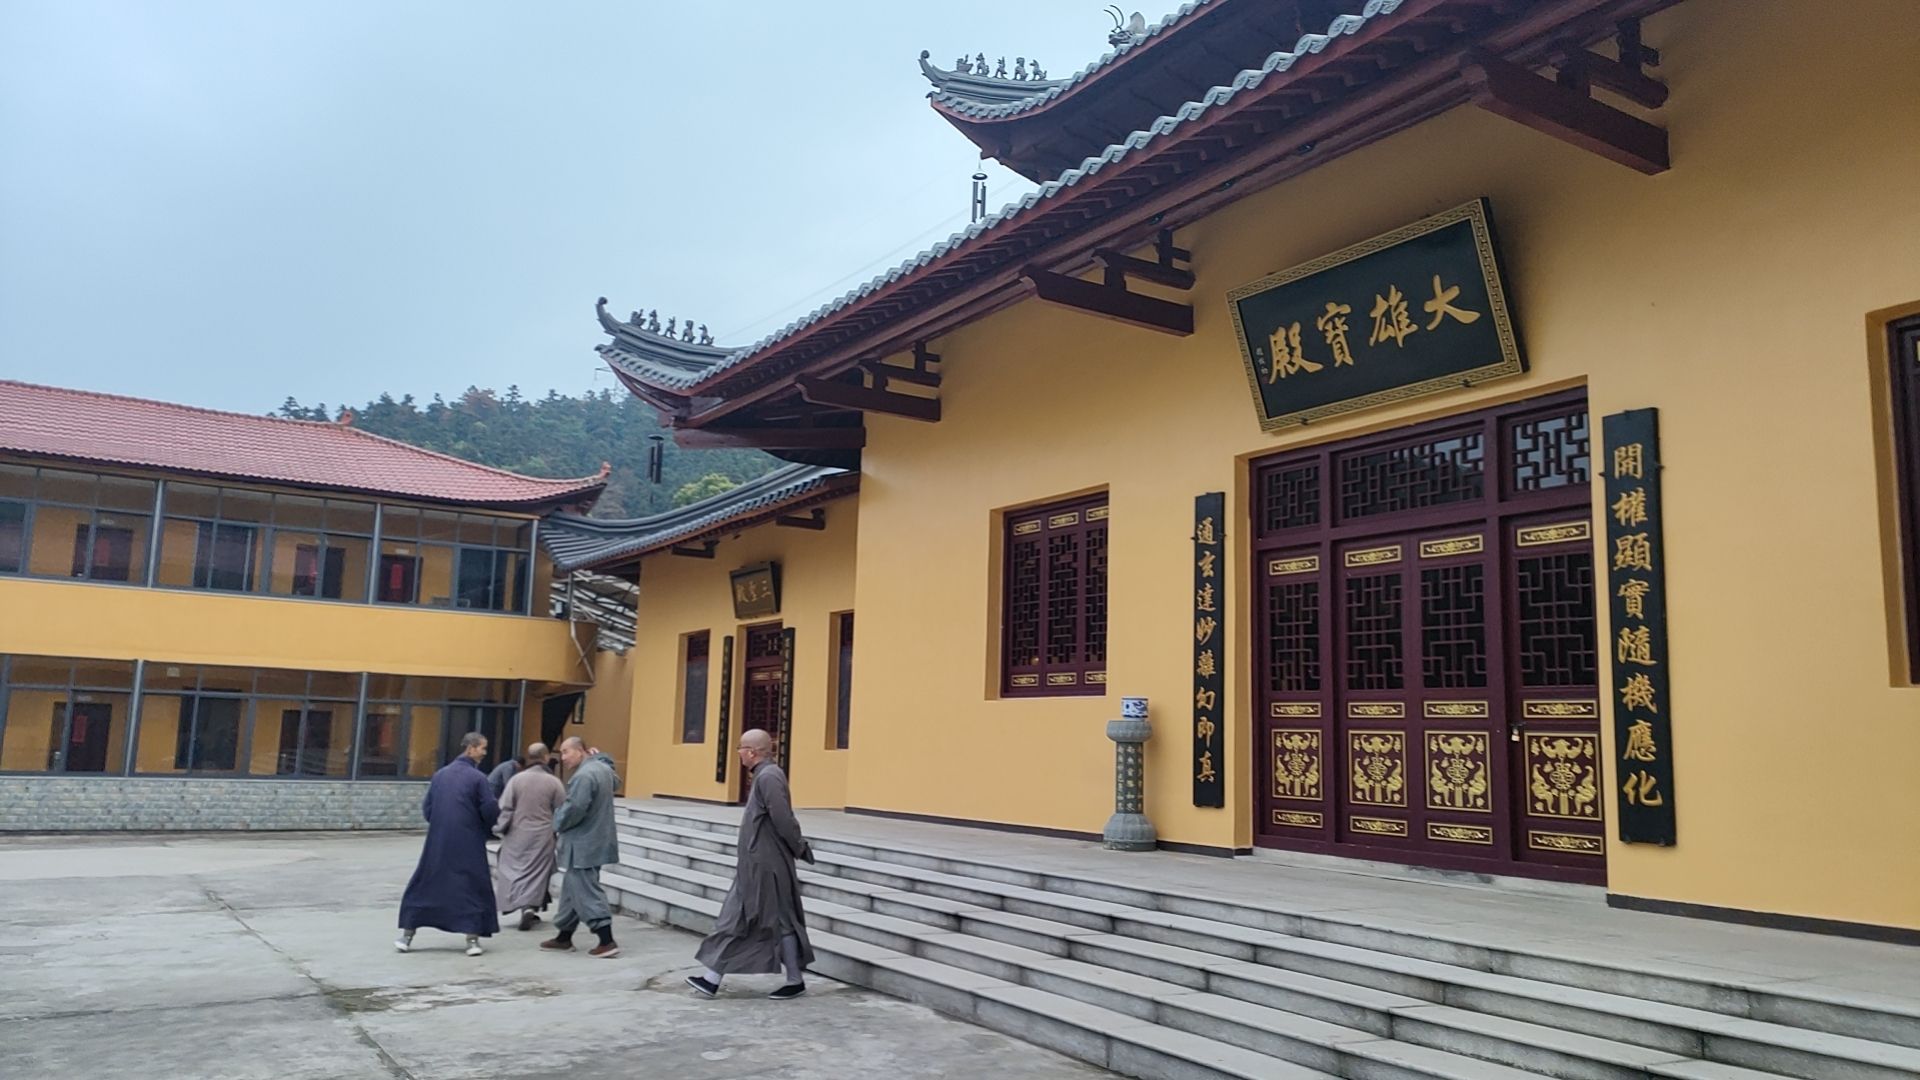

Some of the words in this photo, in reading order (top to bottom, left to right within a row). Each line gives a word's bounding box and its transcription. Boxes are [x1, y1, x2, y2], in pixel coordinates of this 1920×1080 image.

[1269, 275, 1481, 384] 大雄寶殿
[1611, 443, 1663, 806] 開權顯實隨機應化
